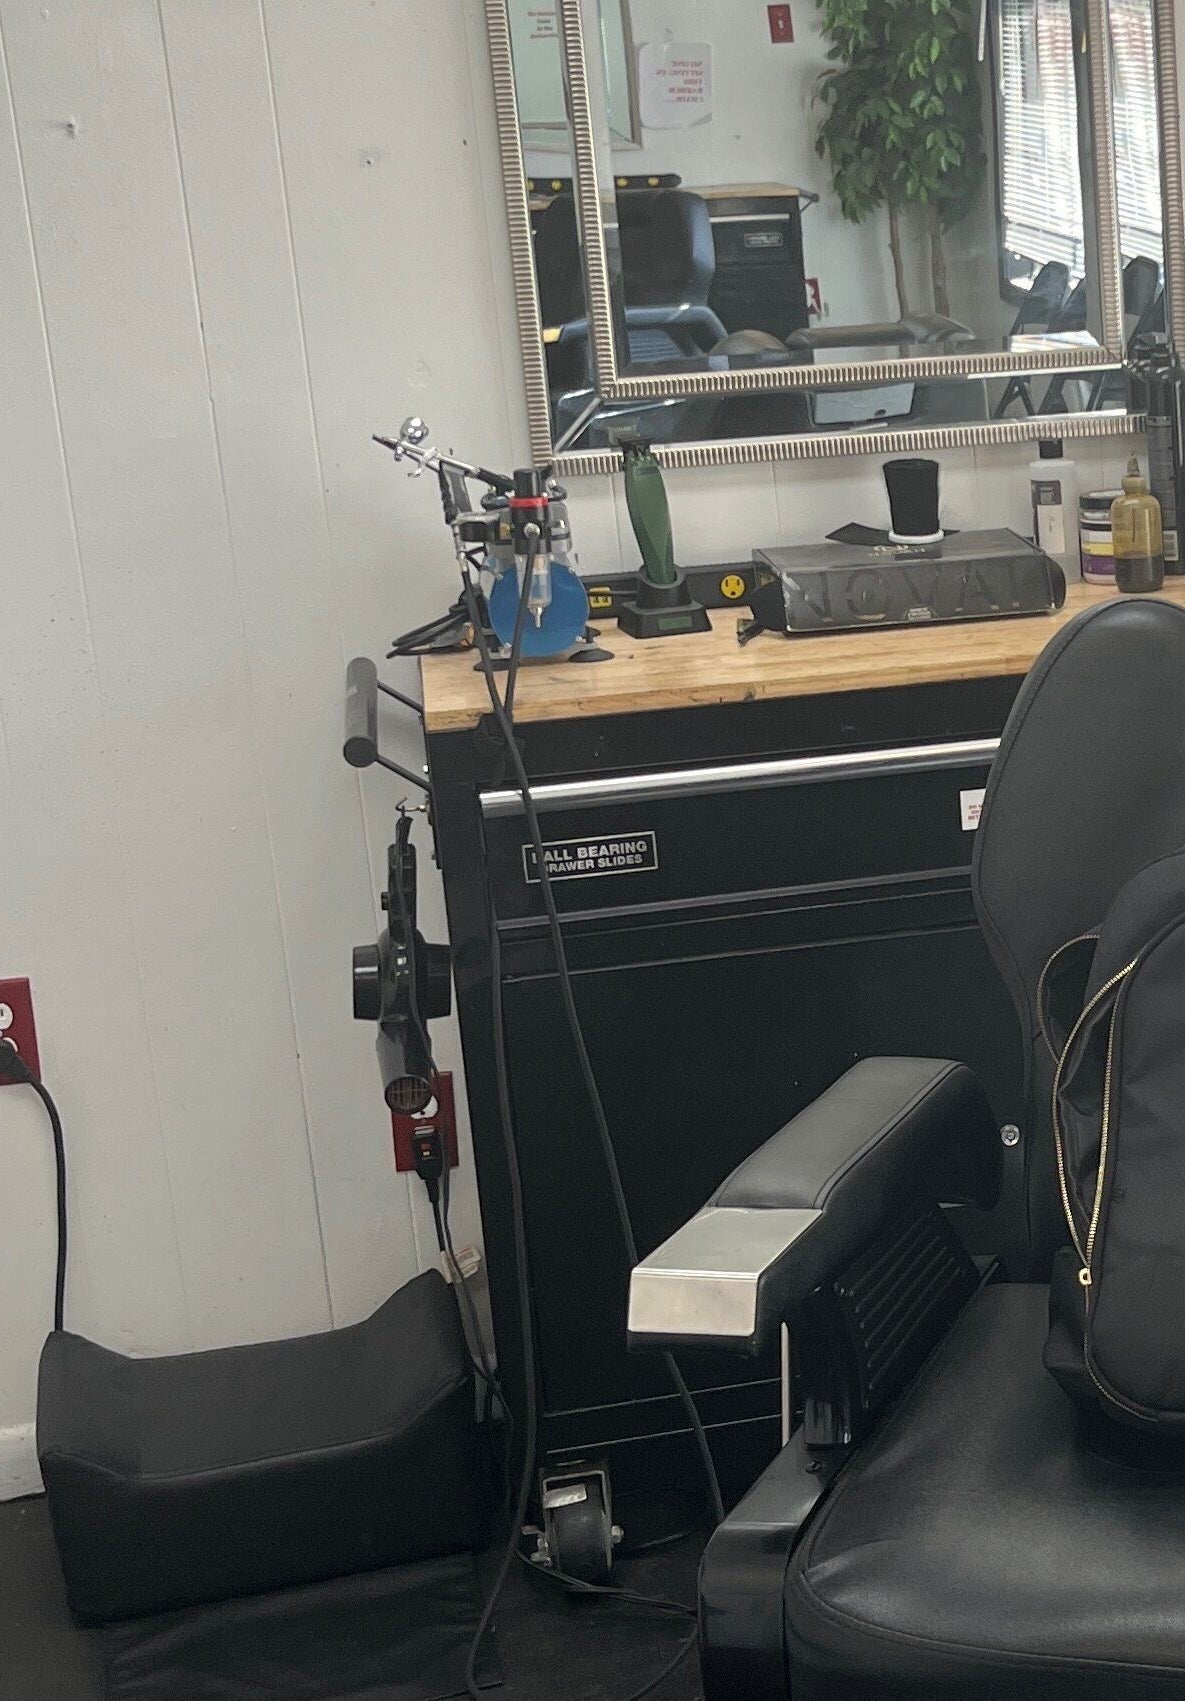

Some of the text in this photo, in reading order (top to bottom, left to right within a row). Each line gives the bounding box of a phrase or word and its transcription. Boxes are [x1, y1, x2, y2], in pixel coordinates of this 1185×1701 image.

[576, 840, 648, 860] BEARING
[545, 854, 643, 873] RAWER SLIDES
